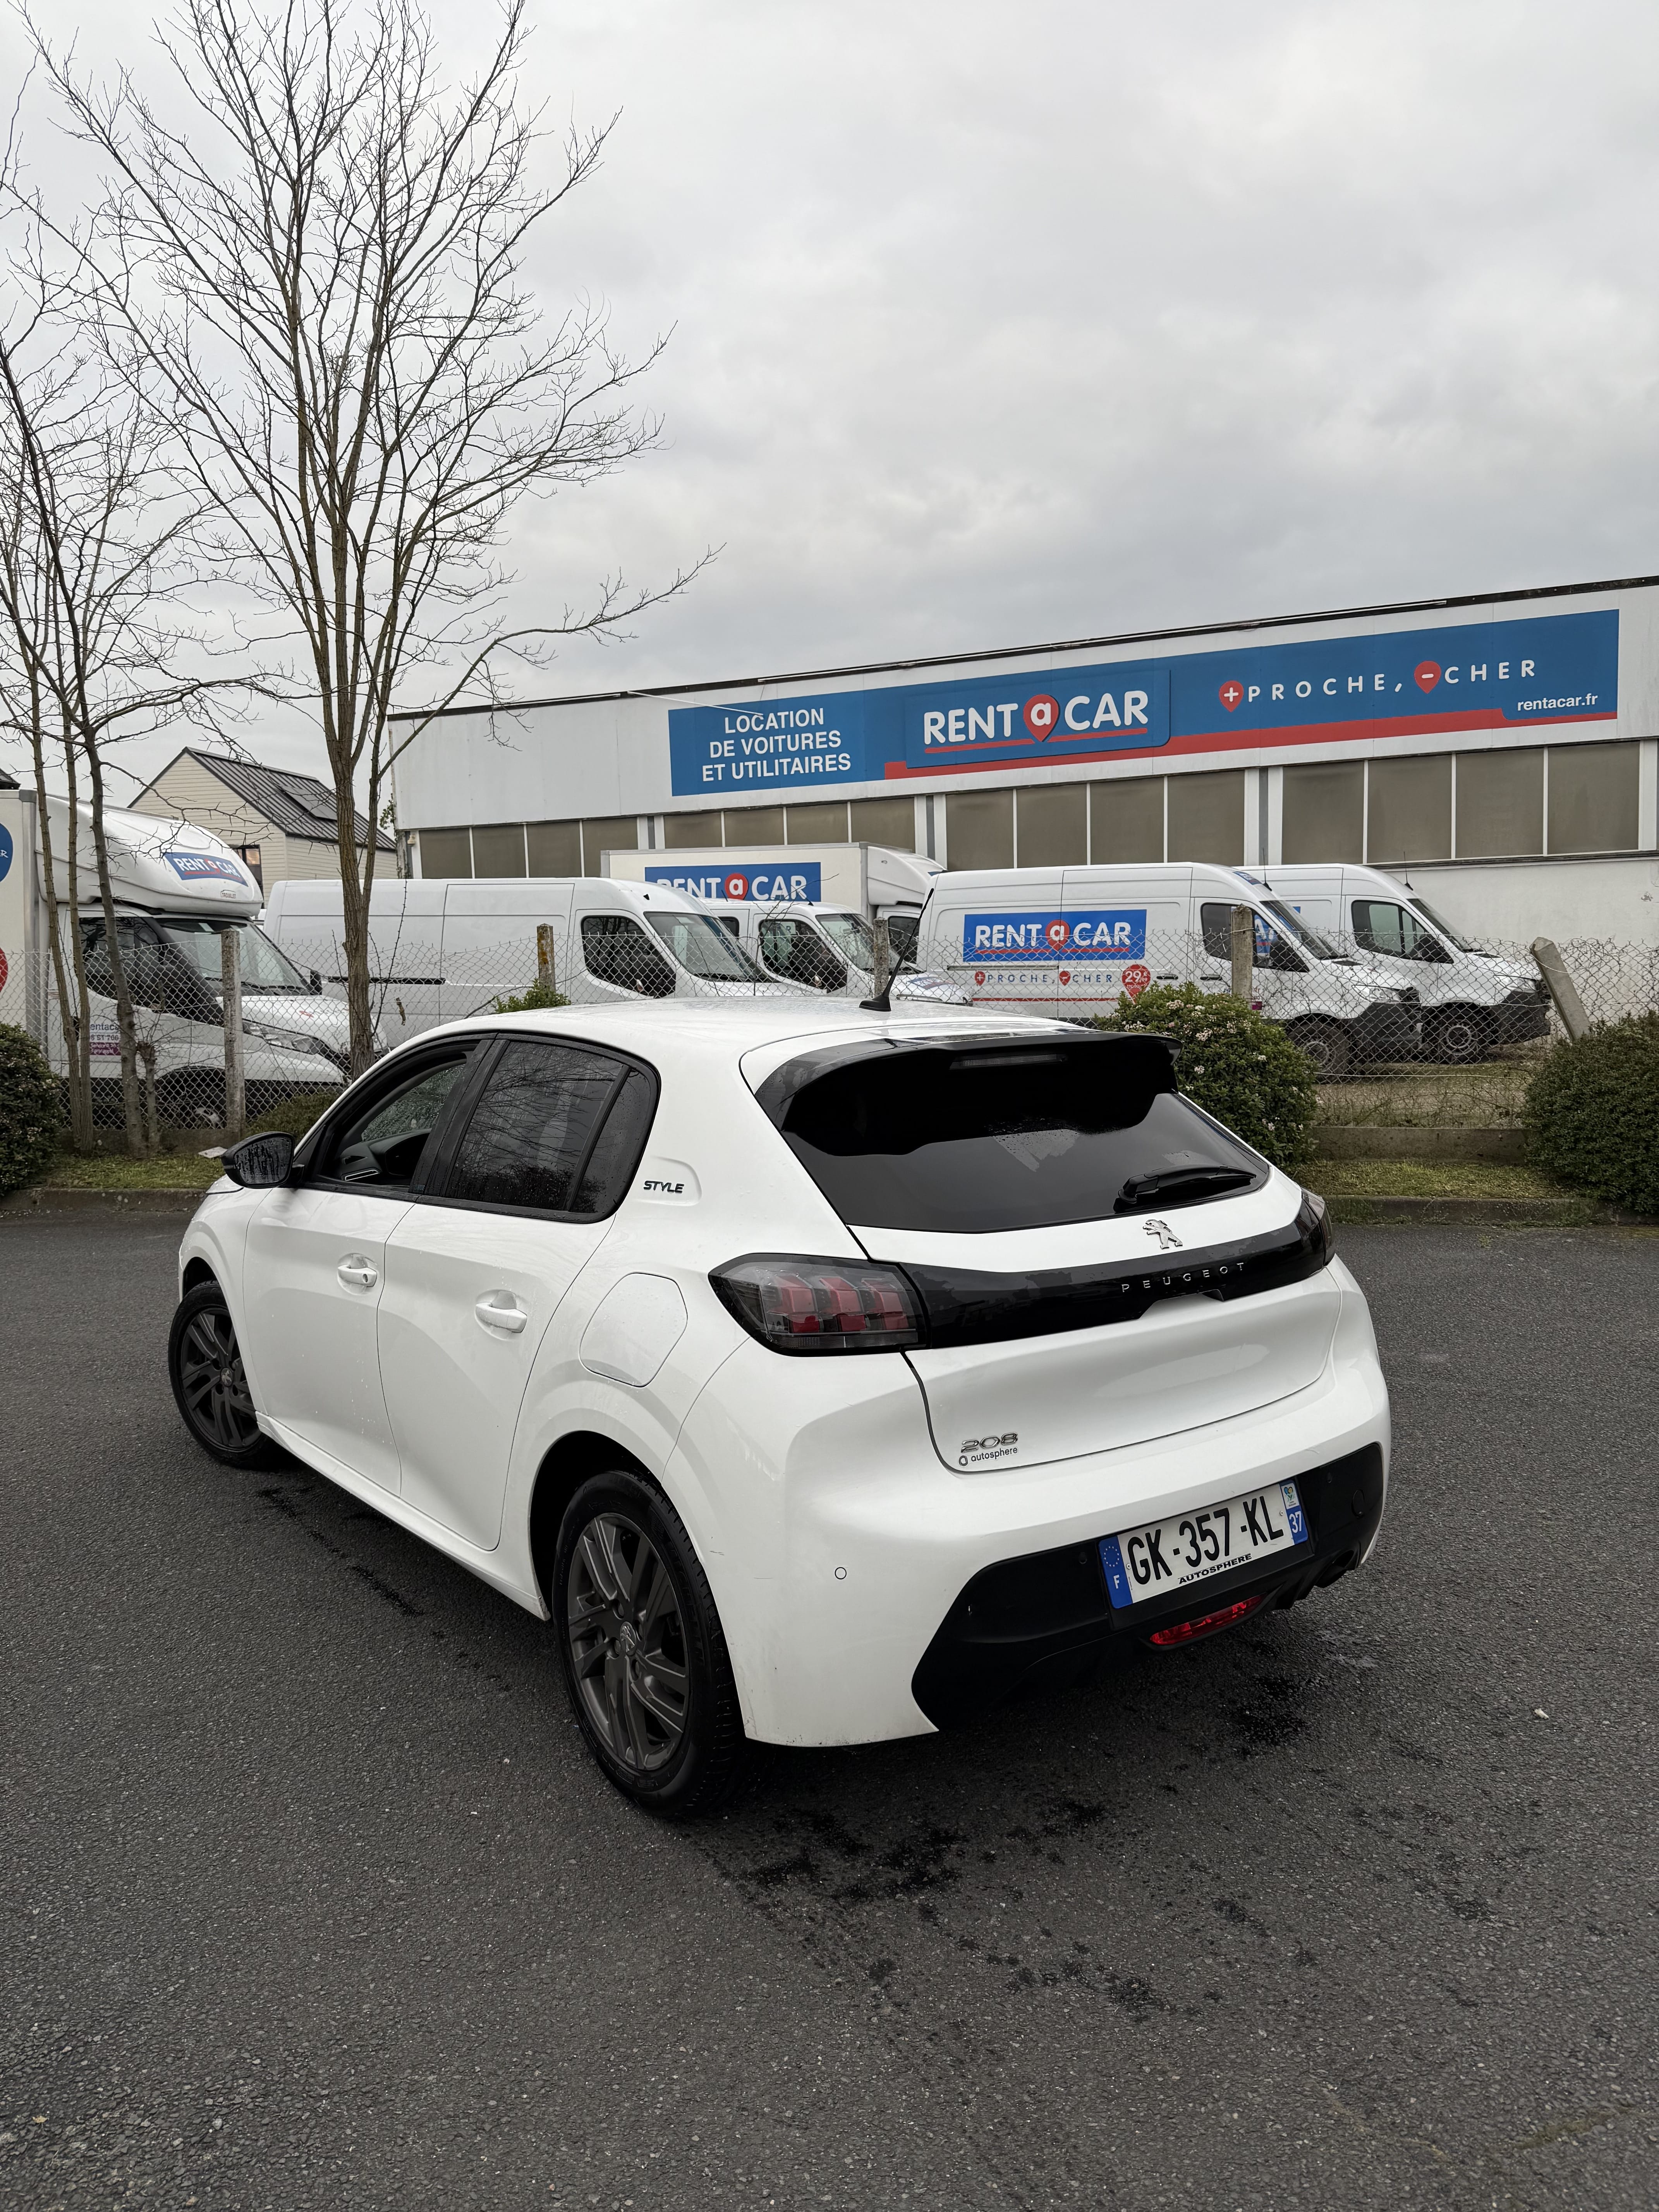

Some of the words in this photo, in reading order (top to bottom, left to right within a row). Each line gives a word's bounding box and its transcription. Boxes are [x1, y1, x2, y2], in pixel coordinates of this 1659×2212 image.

[1248, 672, 1403, 703] PROCHE,
[1444, 659, 1535, 684] CHER
[1517, 693, 1599, 711] rentacar.fr
[725, 708, 824, 734] LOCATION
[924, 703, 1018, 745] RENT
[1030, 702, 1051, 726] a
[1064, 690, 1149, 730] CAR
[710, 740, 735, 758] DE
[741, 730, 841, 755] VOITURES
[702, 764, 725, 781] ET
[732, 753, 851, 780] UTILITAIRES
[173, 858, 210, 871] RENT
[215, 862, 240, 878] CAR
[729, 878, 743, 895] a
[752, 876, 807, 900] CAR
[975, 924, 1042, 948] RENT
[1050, 925, 1064, 941] a
[1073, 922, 1131, 946] CAR
[1073, 974, 1112, 983] CHER
[643, 1180, 684, 1194] STYLE
[1121, 1262, 1244, 1292] PEUGEOT
[960, 1432, 1018, 1453] 208
[971, 1447, 1018, 1460] autosphere
[1289, 1511, 1302, 1534] 37
[1128, 1496, 1284, 1585] GK-357-KL
[1178, 1553, 1252, 1584] AUTOSPHERE
[1113, 1575, 1120, 1589] F
